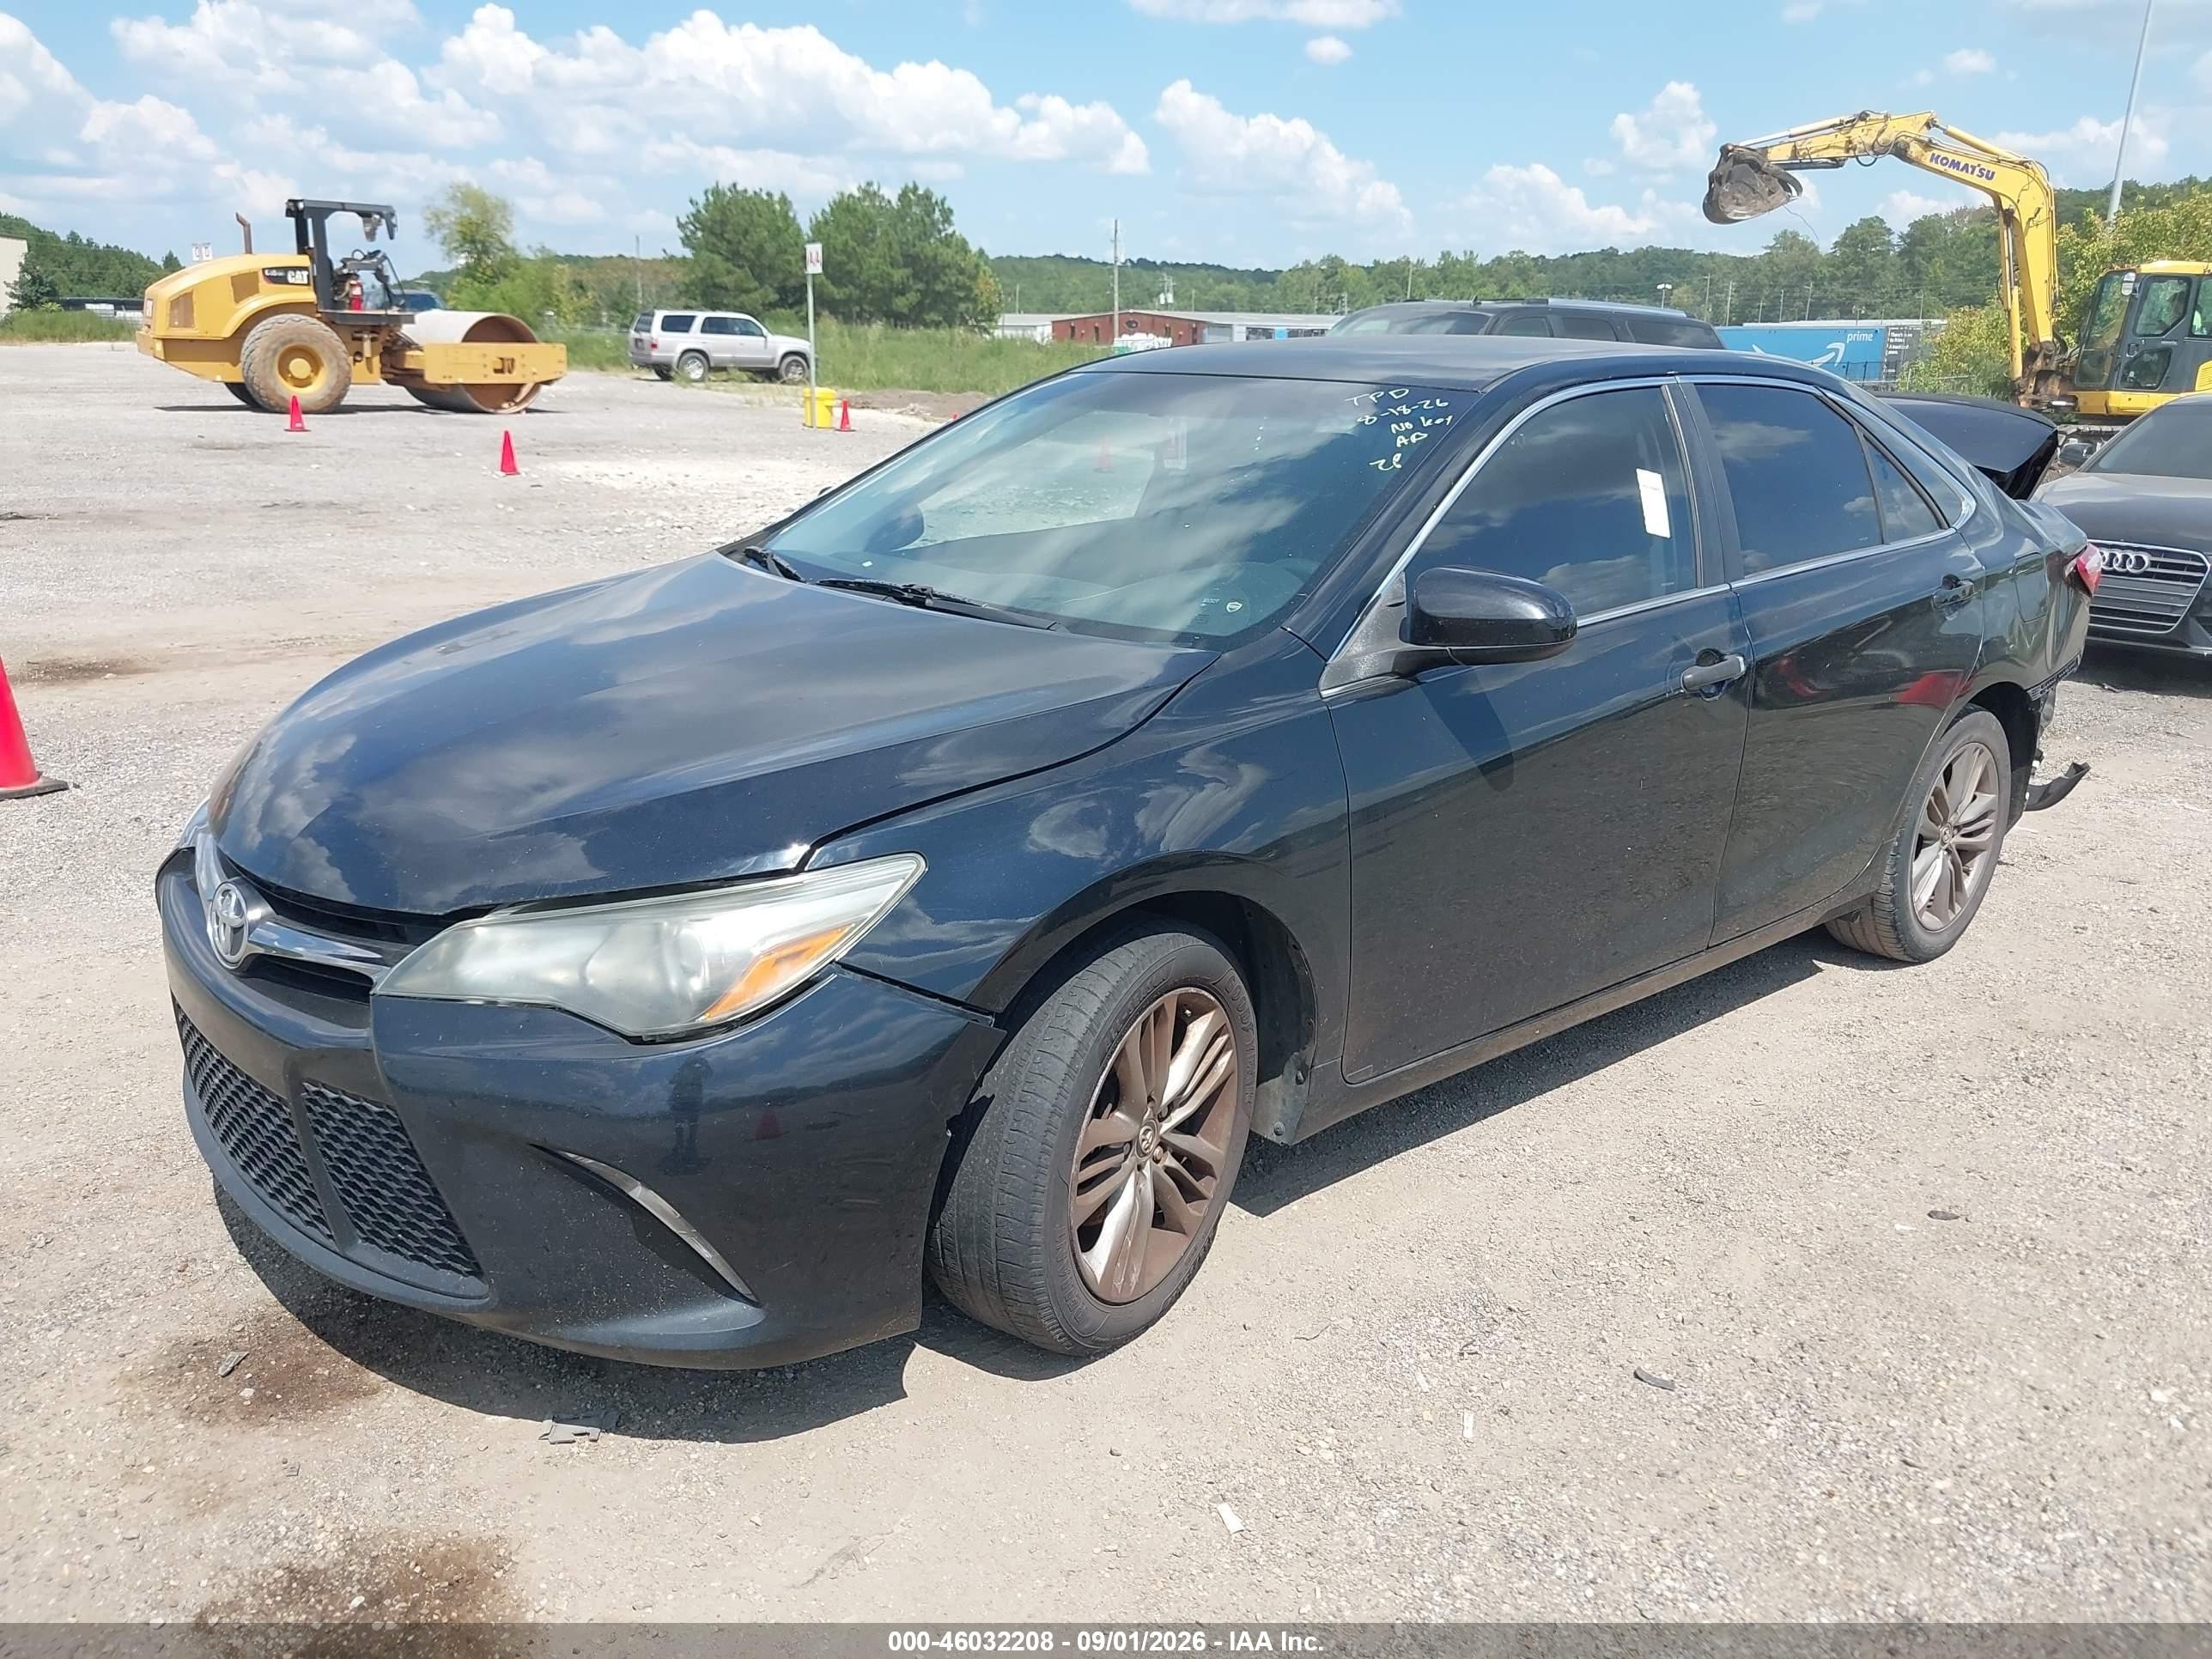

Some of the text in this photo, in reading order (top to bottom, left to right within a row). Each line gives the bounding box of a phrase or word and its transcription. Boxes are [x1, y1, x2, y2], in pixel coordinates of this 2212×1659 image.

[1929, 153, 1996, 180] KOMATSU
[287, 270, 308, 284] CAT
[1847, 331, 1874, 343] prime
[1345, 388, 1410, 406] TPD
[1357, 398, 1449, 425] 8-18-26
